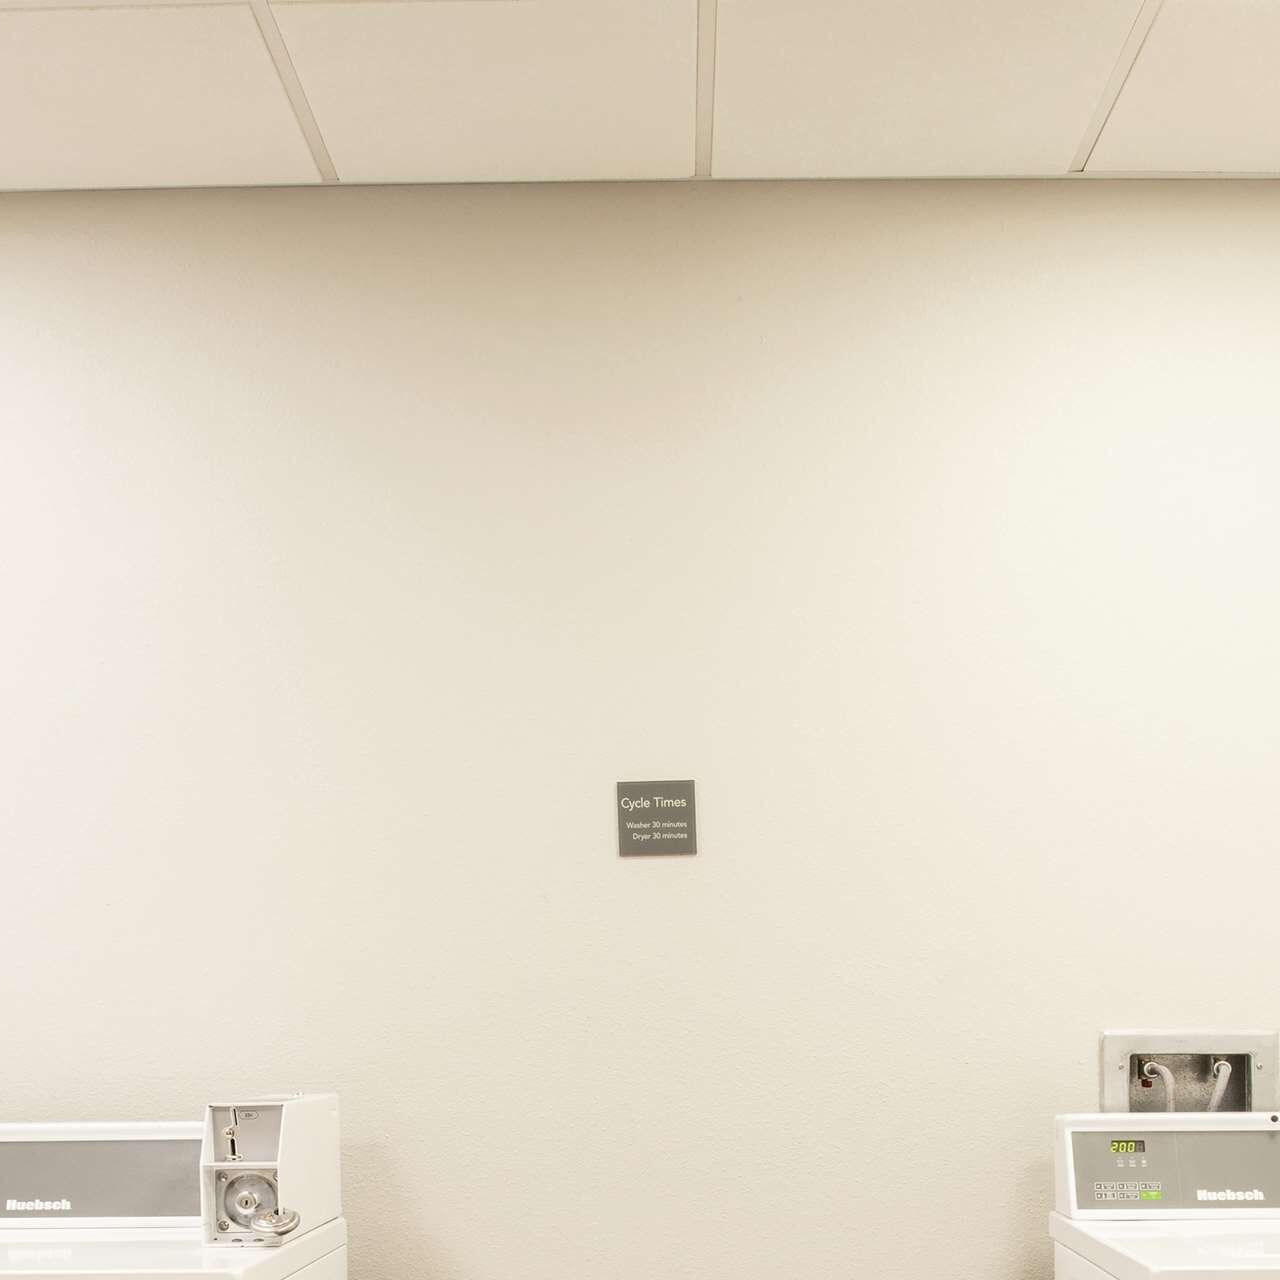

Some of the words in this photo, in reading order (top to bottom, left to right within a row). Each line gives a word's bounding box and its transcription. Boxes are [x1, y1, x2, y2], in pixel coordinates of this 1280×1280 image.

[621, 797, 651, 811] Cycle
[653, 797, 687, 808] Times
[652, 821, 661, 829] 30
[632, 833, 651, 841] Dryer
[652, 832, 661, 840] 30
[1111, 1142, 1136, 1153] 200
[1197, 1189, 1265, 1201] Huebsch
[6, 1199, 72, 1211] Huebsch
